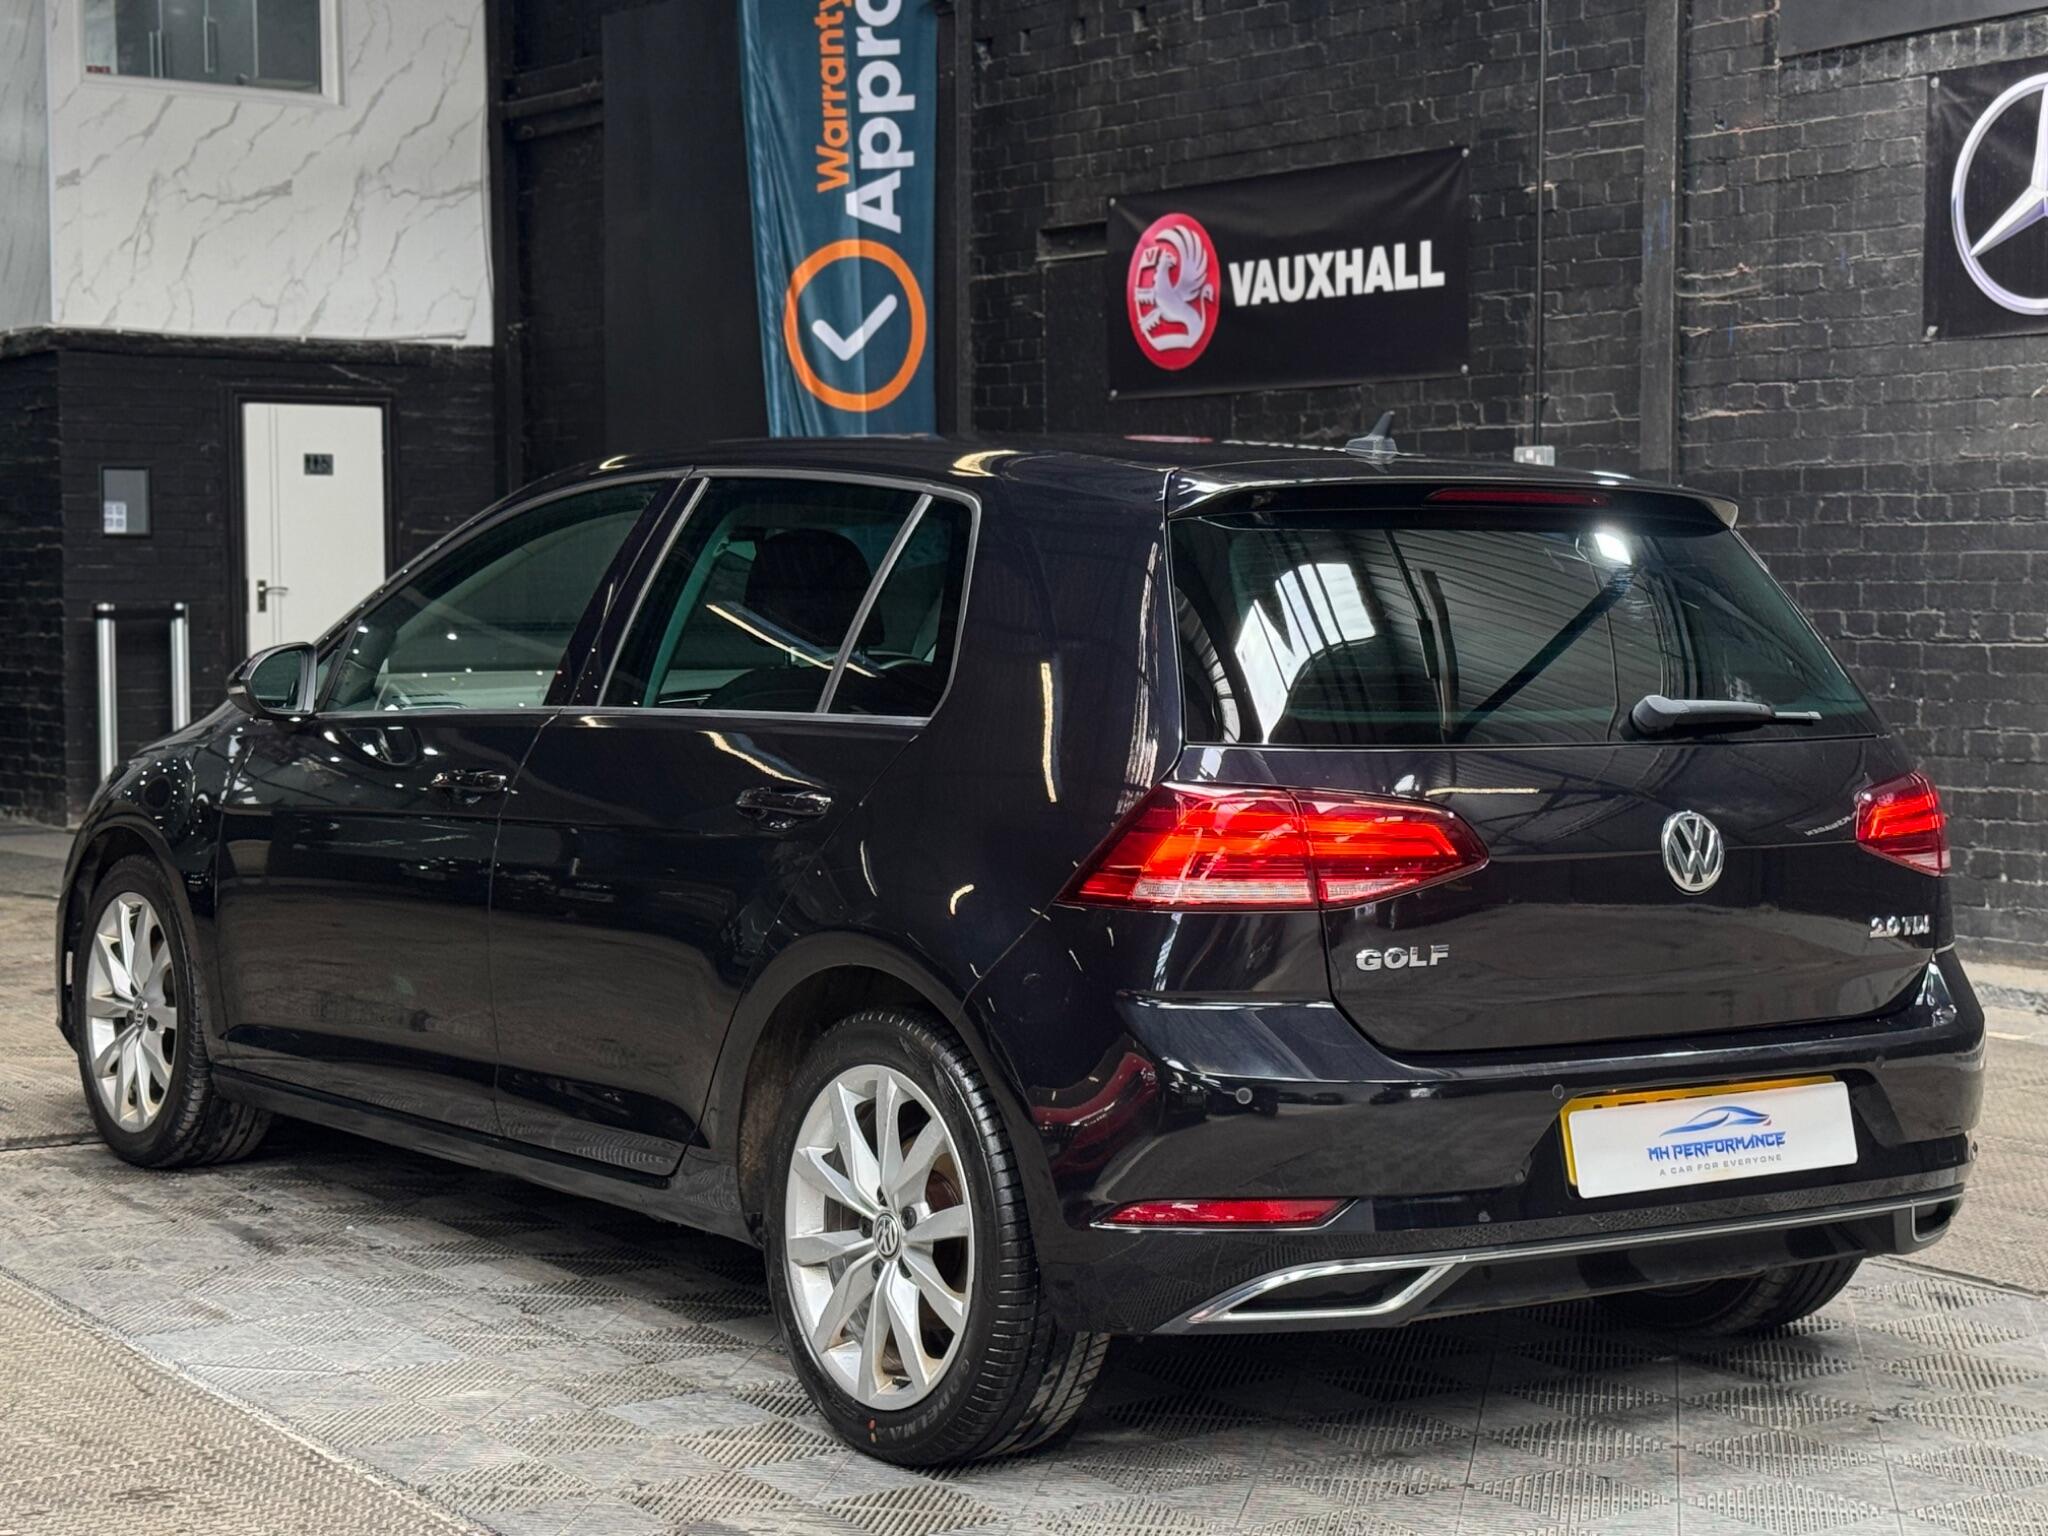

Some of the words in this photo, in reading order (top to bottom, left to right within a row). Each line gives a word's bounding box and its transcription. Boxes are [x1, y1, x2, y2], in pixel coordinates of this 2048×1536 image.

[1228, 240, 1445, 307] VAUXHALL
[1355, 944, 1450, 971] GOLF
[1646, 1143, 1671, 1163] MH
[1671, 1131, 1787, 1160] PERFORMANCE
[1659, 1169, 1667, 1177] A
[1670, 1165, 1694, 1175] CAR
[1697, 1161, 1719, 1171] FOR
[1724, 1154, 1783, 1168] EVERYONE
